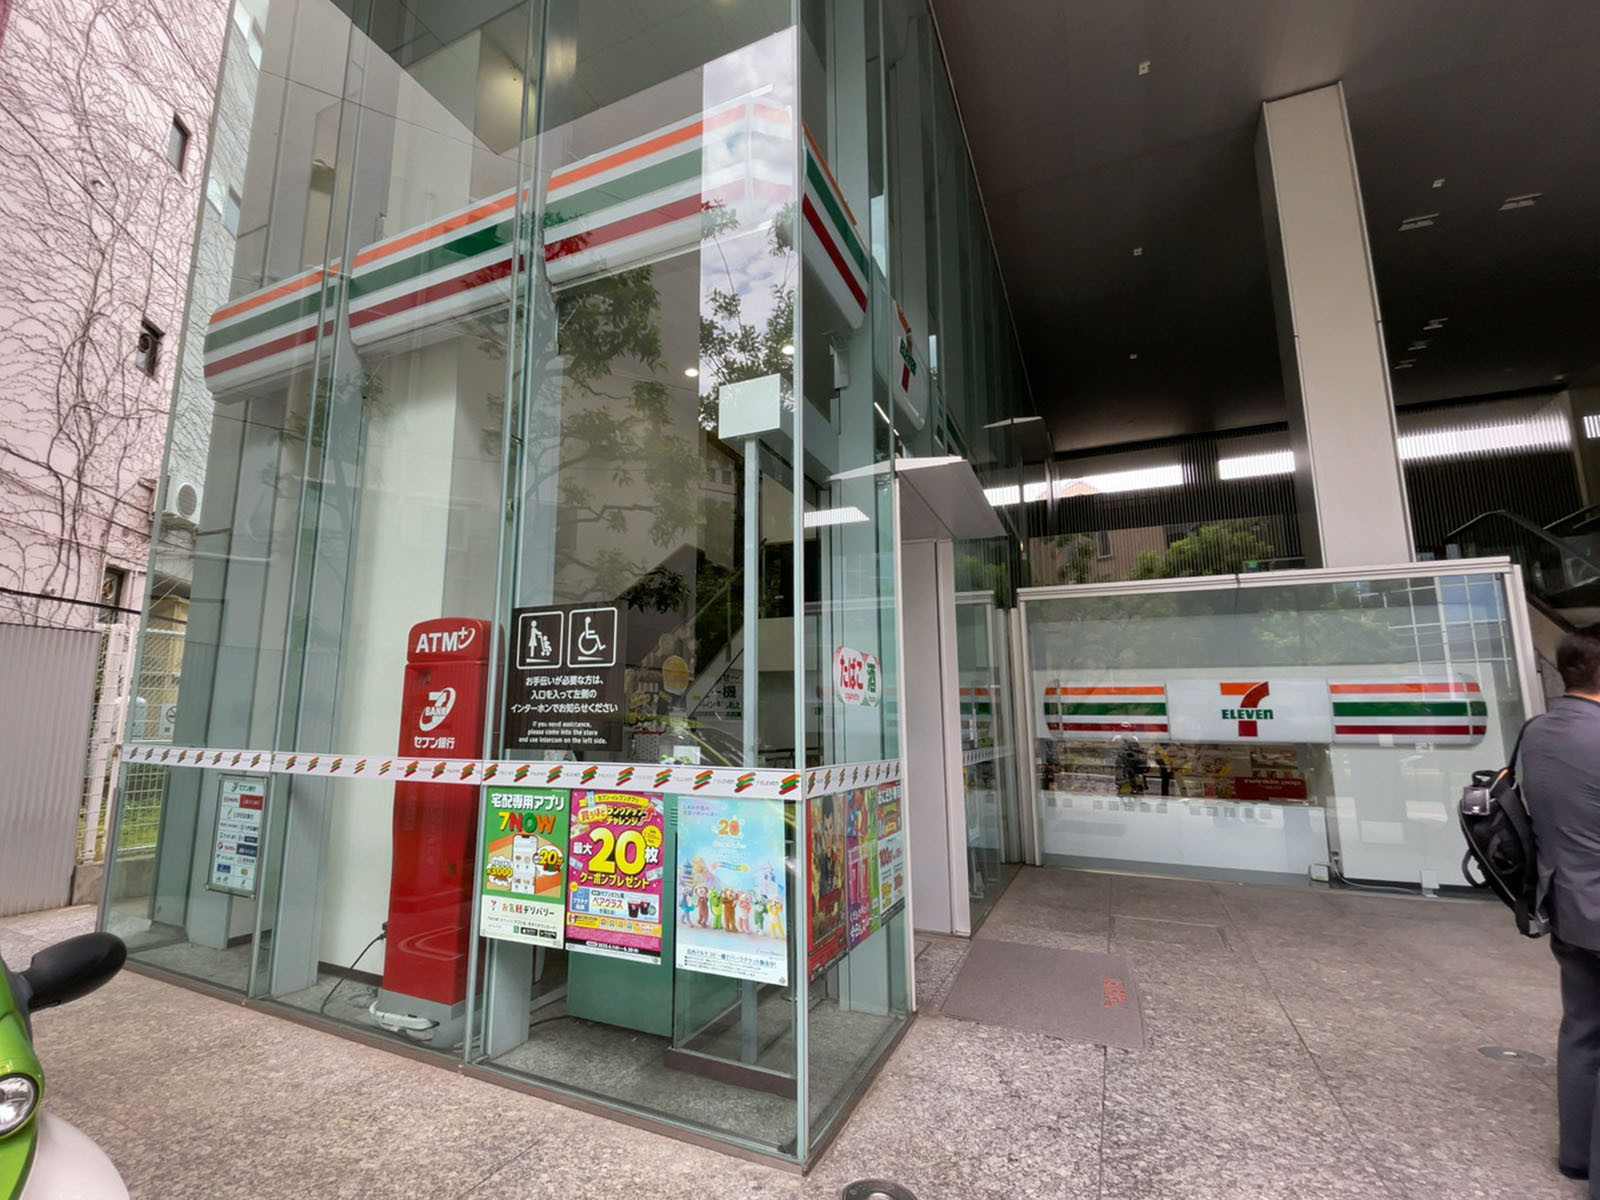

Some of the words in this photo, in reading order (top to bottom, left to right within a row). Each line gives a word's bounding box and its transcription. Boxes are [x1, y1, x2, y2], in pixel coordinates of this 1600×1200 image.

[840, 656, 864, 690] たばこ
[510, 703, 619, 714] インターホンでお知らせください
[538, 721, 547, 729] you
[413, 735, 456, 750] セブン銀行
[491, 793, 565, 811] 宅配専用アプリ
[498, 811, 556, 834] 7NOW
[573, 841, 592, 855] 最大
[588, 827, 646, 875] 20
[644, 846, 660, 864] 枚
[580, 872, 651, 890] クーポンプレゼント
